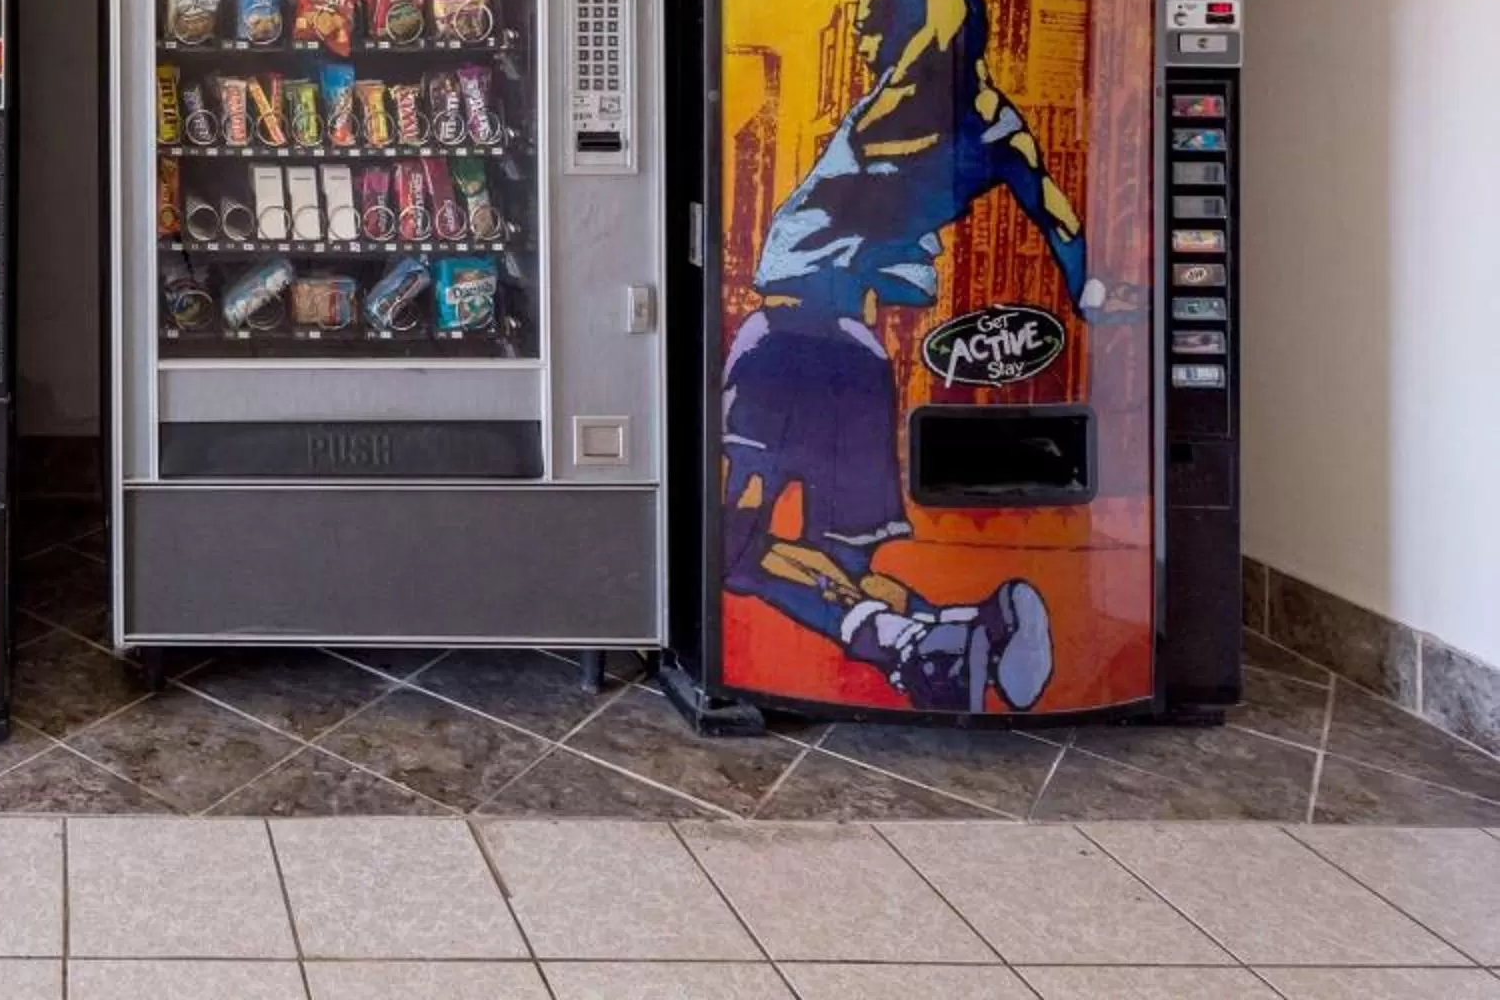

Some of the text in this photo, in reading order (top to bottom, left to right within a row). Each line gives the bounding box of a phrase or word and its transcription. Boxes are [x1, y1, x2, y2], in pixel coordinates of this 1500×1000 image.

[945, 320, 1044, 388] ACTIVE
[987, 361, 1026, 379] Stay
[306, 432, 395, 466] PUSH
